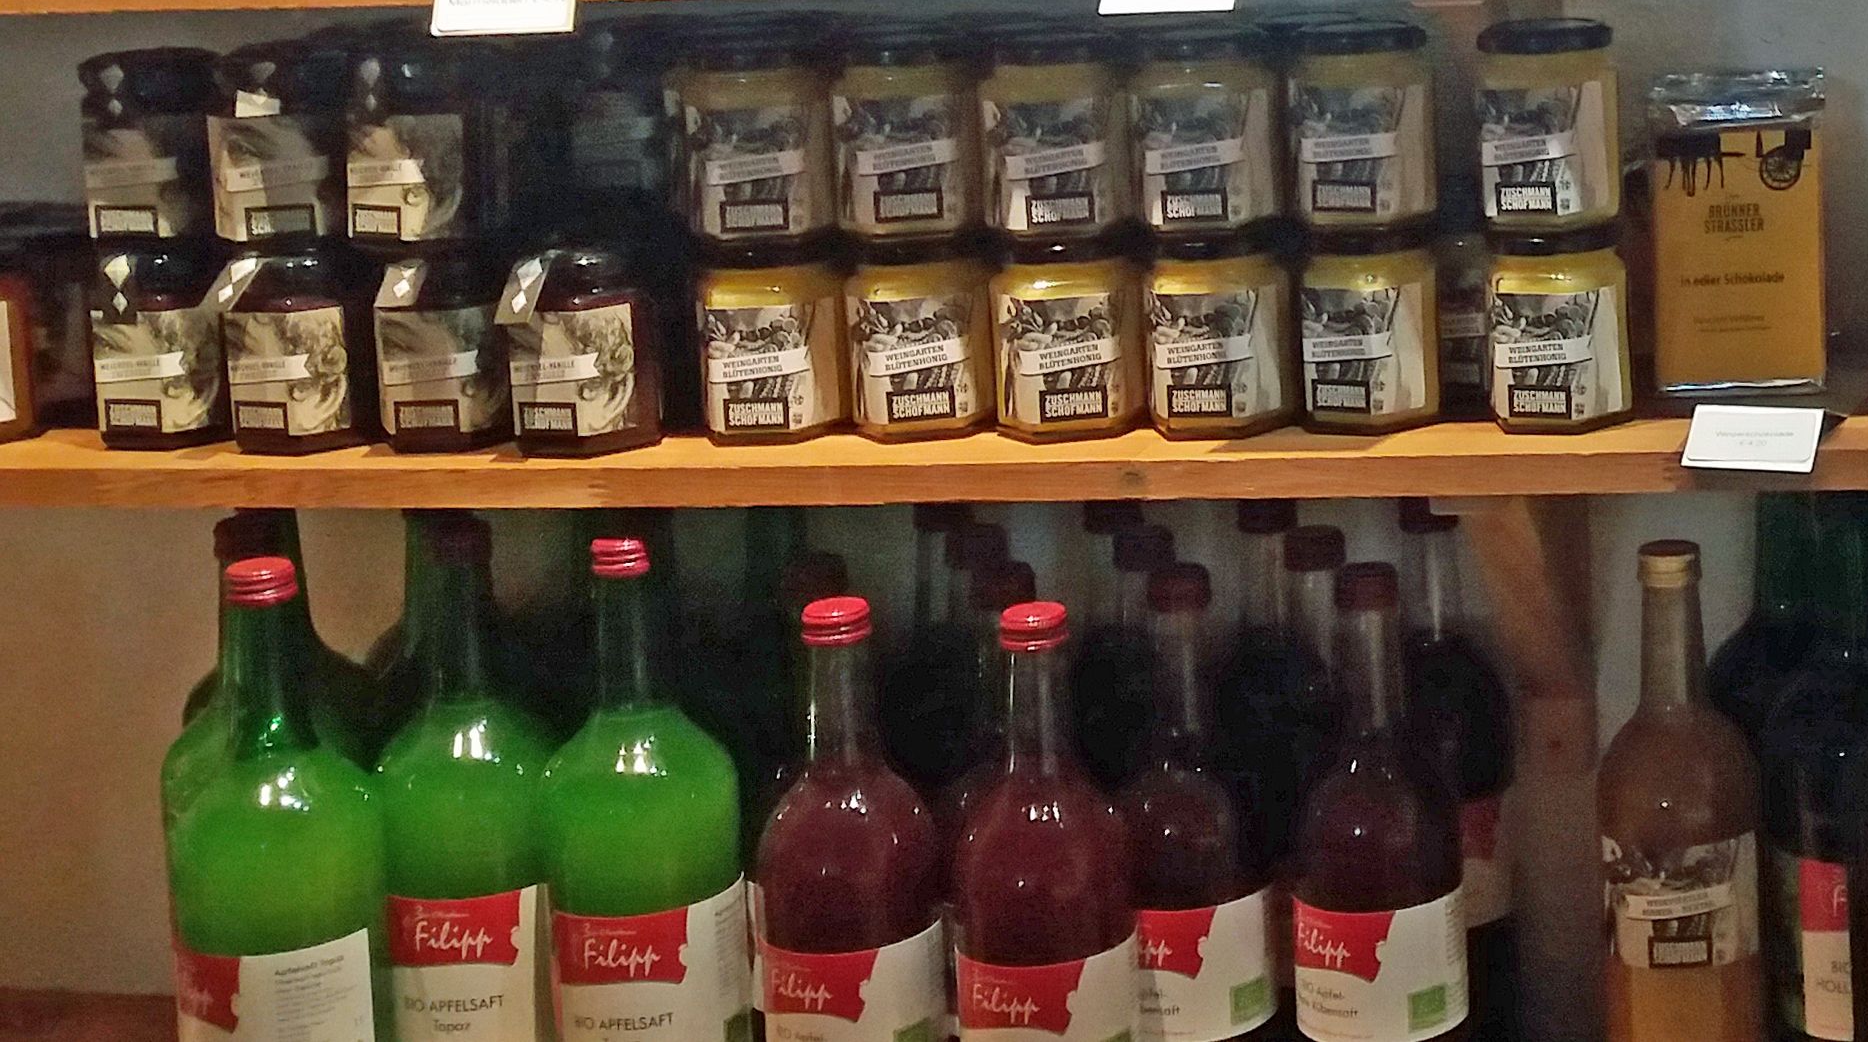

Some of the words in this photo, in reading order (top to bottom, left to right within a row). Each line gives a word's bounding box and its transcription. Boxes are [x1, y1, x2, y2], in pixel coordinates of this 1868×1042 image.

[1501, 187, 1551, 199] ZUSCHMANN
[1724, 270, 1785, 286] Schokolade
[885, 345, 945, 361] WEINGARTEN
[1039, 344, 1099, 360] WEINGARTEN
[1167, 341, 1224, 355] WEINGARTEN
[1509, 343, 1564, 355] WEINGARTEN
[722, 355, 780, 369] WEINGARTEN
[885, 353, 948, 371] BLÜTENHONIG
[1039, 354, 1101, 369] BLÜTENHONIG
[722, 364, 783, 378] BLÜTENHONIG
[892, 391, 950, 405] ZUSCHMANN
[1045, 390, 1101, 405] ZUSCHMANN
[1172, 389, 1227, 401] ZUSCHMANN
[1513, 389, 1566, 402] ZUSCHMANN
[728, 402, 784, 414] ZUSCHMANN
[414, 921, 493, 960] Filipp
[1298, 922, 1351, 969] Filipp
[583, 939, 662, 978] Filipp
[772, 968, 834, 1011] Filipp
[430, 994, 505, 1013] APFELSAFT
[973, 983, 1041, 1026] Filipp
[433, 1018, 471, 1033] Topaz
[599, 1012, 674, 1031] APFELSAFT
